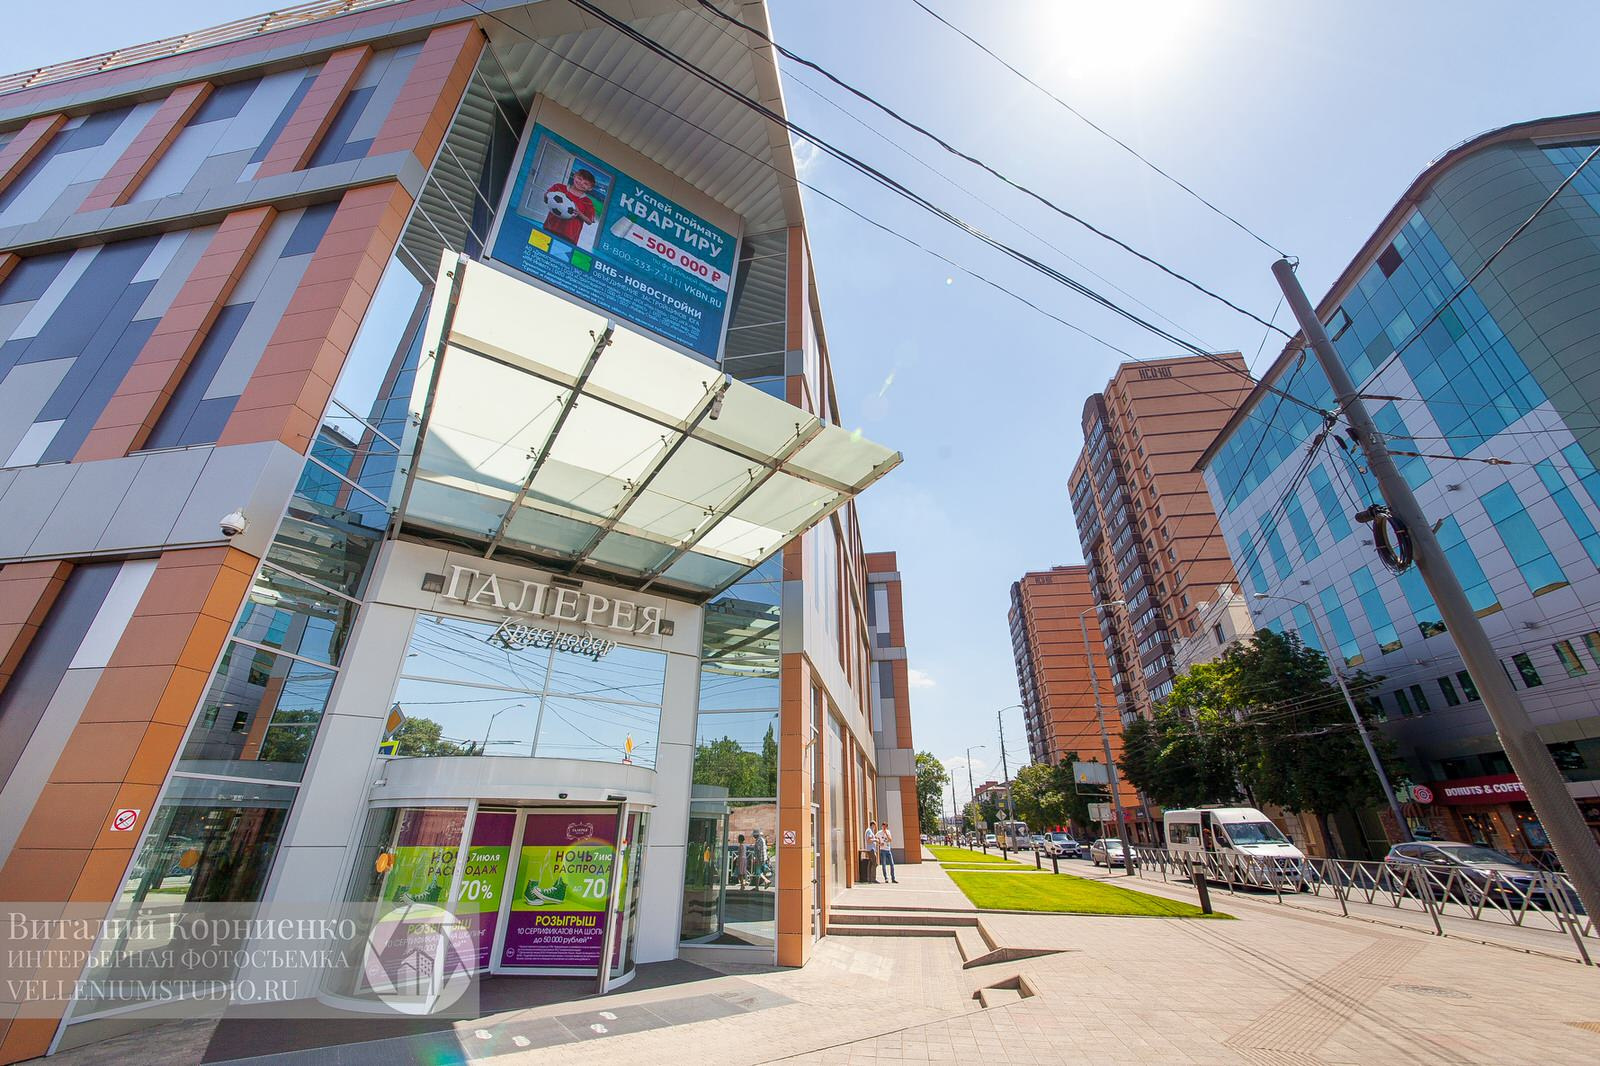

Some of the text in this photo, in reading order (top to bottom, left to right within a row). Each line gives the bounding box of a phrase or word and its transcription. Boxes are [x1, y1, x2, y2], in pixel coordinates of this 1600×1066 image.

[634, 186, 724, 244] Успей поймать
[618, 192, 721, 261] КВАРТИРУ
[679, 253, 708, 277] 000
[683, 283, 721, 308] VKBN.RU
[443, 564, 664, 637] ГАЛЕРЕЯ
[493, 615, 618, 658] Краснодар
[1445, 786, 1482, 797] DONUTS
[1484, 784, 1493, 794] &
[556, 850, 593, 863] НОЧЬ
[553, 864, 612, 875] РАСПРОДА
[582, 878, 606, 899] 70
[517, 927, 525, 935] 10
[525, 927, 573, 935] СЕРТИФИКАТОВ
[574, 927, 583, 935] НА
[535, 915, 597, 927] РОЗЫГРЫШ
